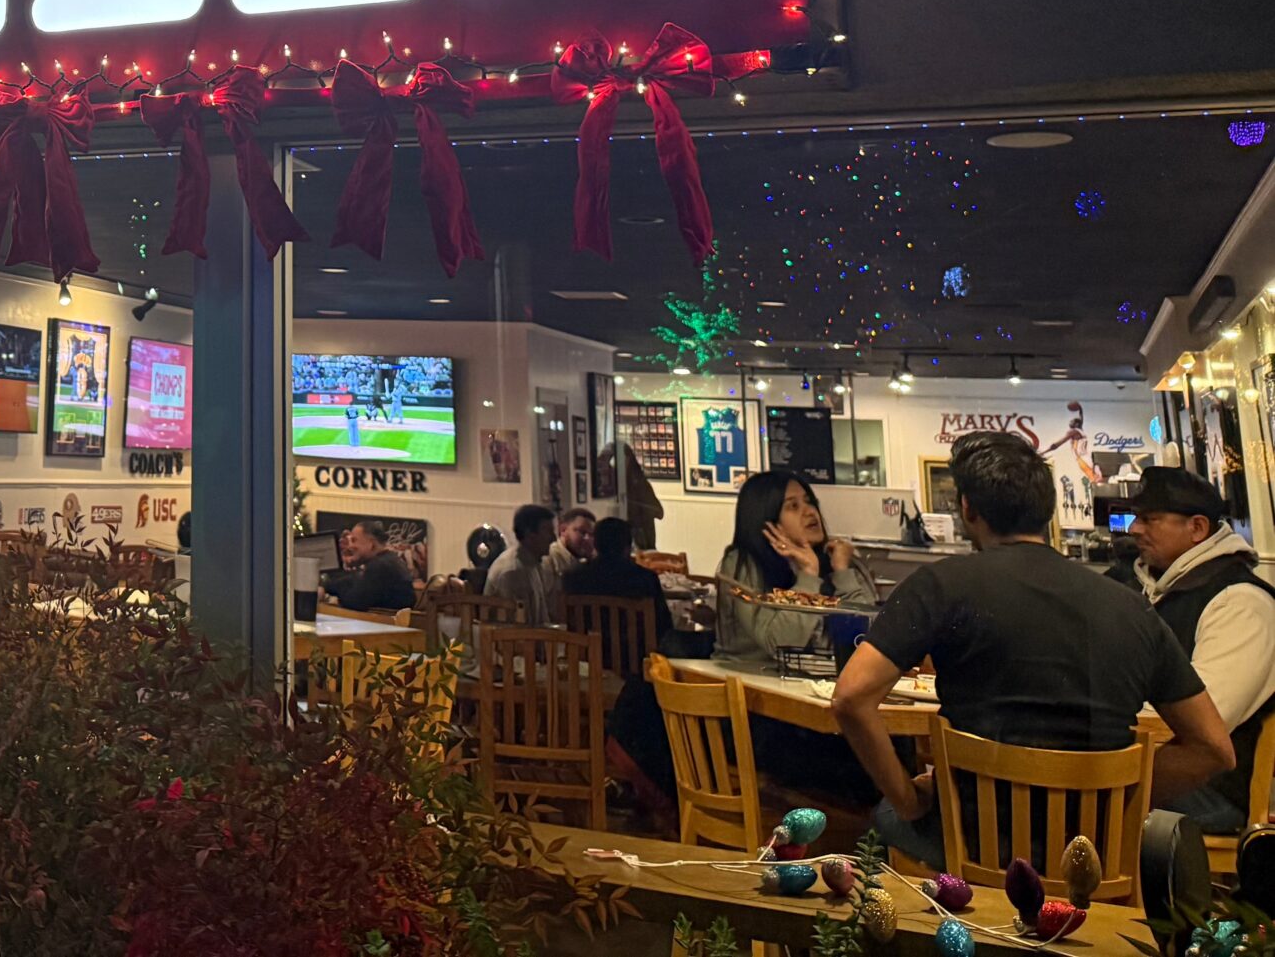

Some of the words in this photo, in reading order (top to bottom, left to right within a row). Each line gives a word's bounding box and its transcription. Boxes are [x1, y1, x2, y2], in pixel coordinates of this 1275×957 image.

[1094, 432, 1144, 452] Dodgers
[129, 452, 183, 476] COACH'S
[314, 465, 428, 493] CORNER
[91, 506, 122, 522] 49ERS
[153, 498, 177, 522] USC
